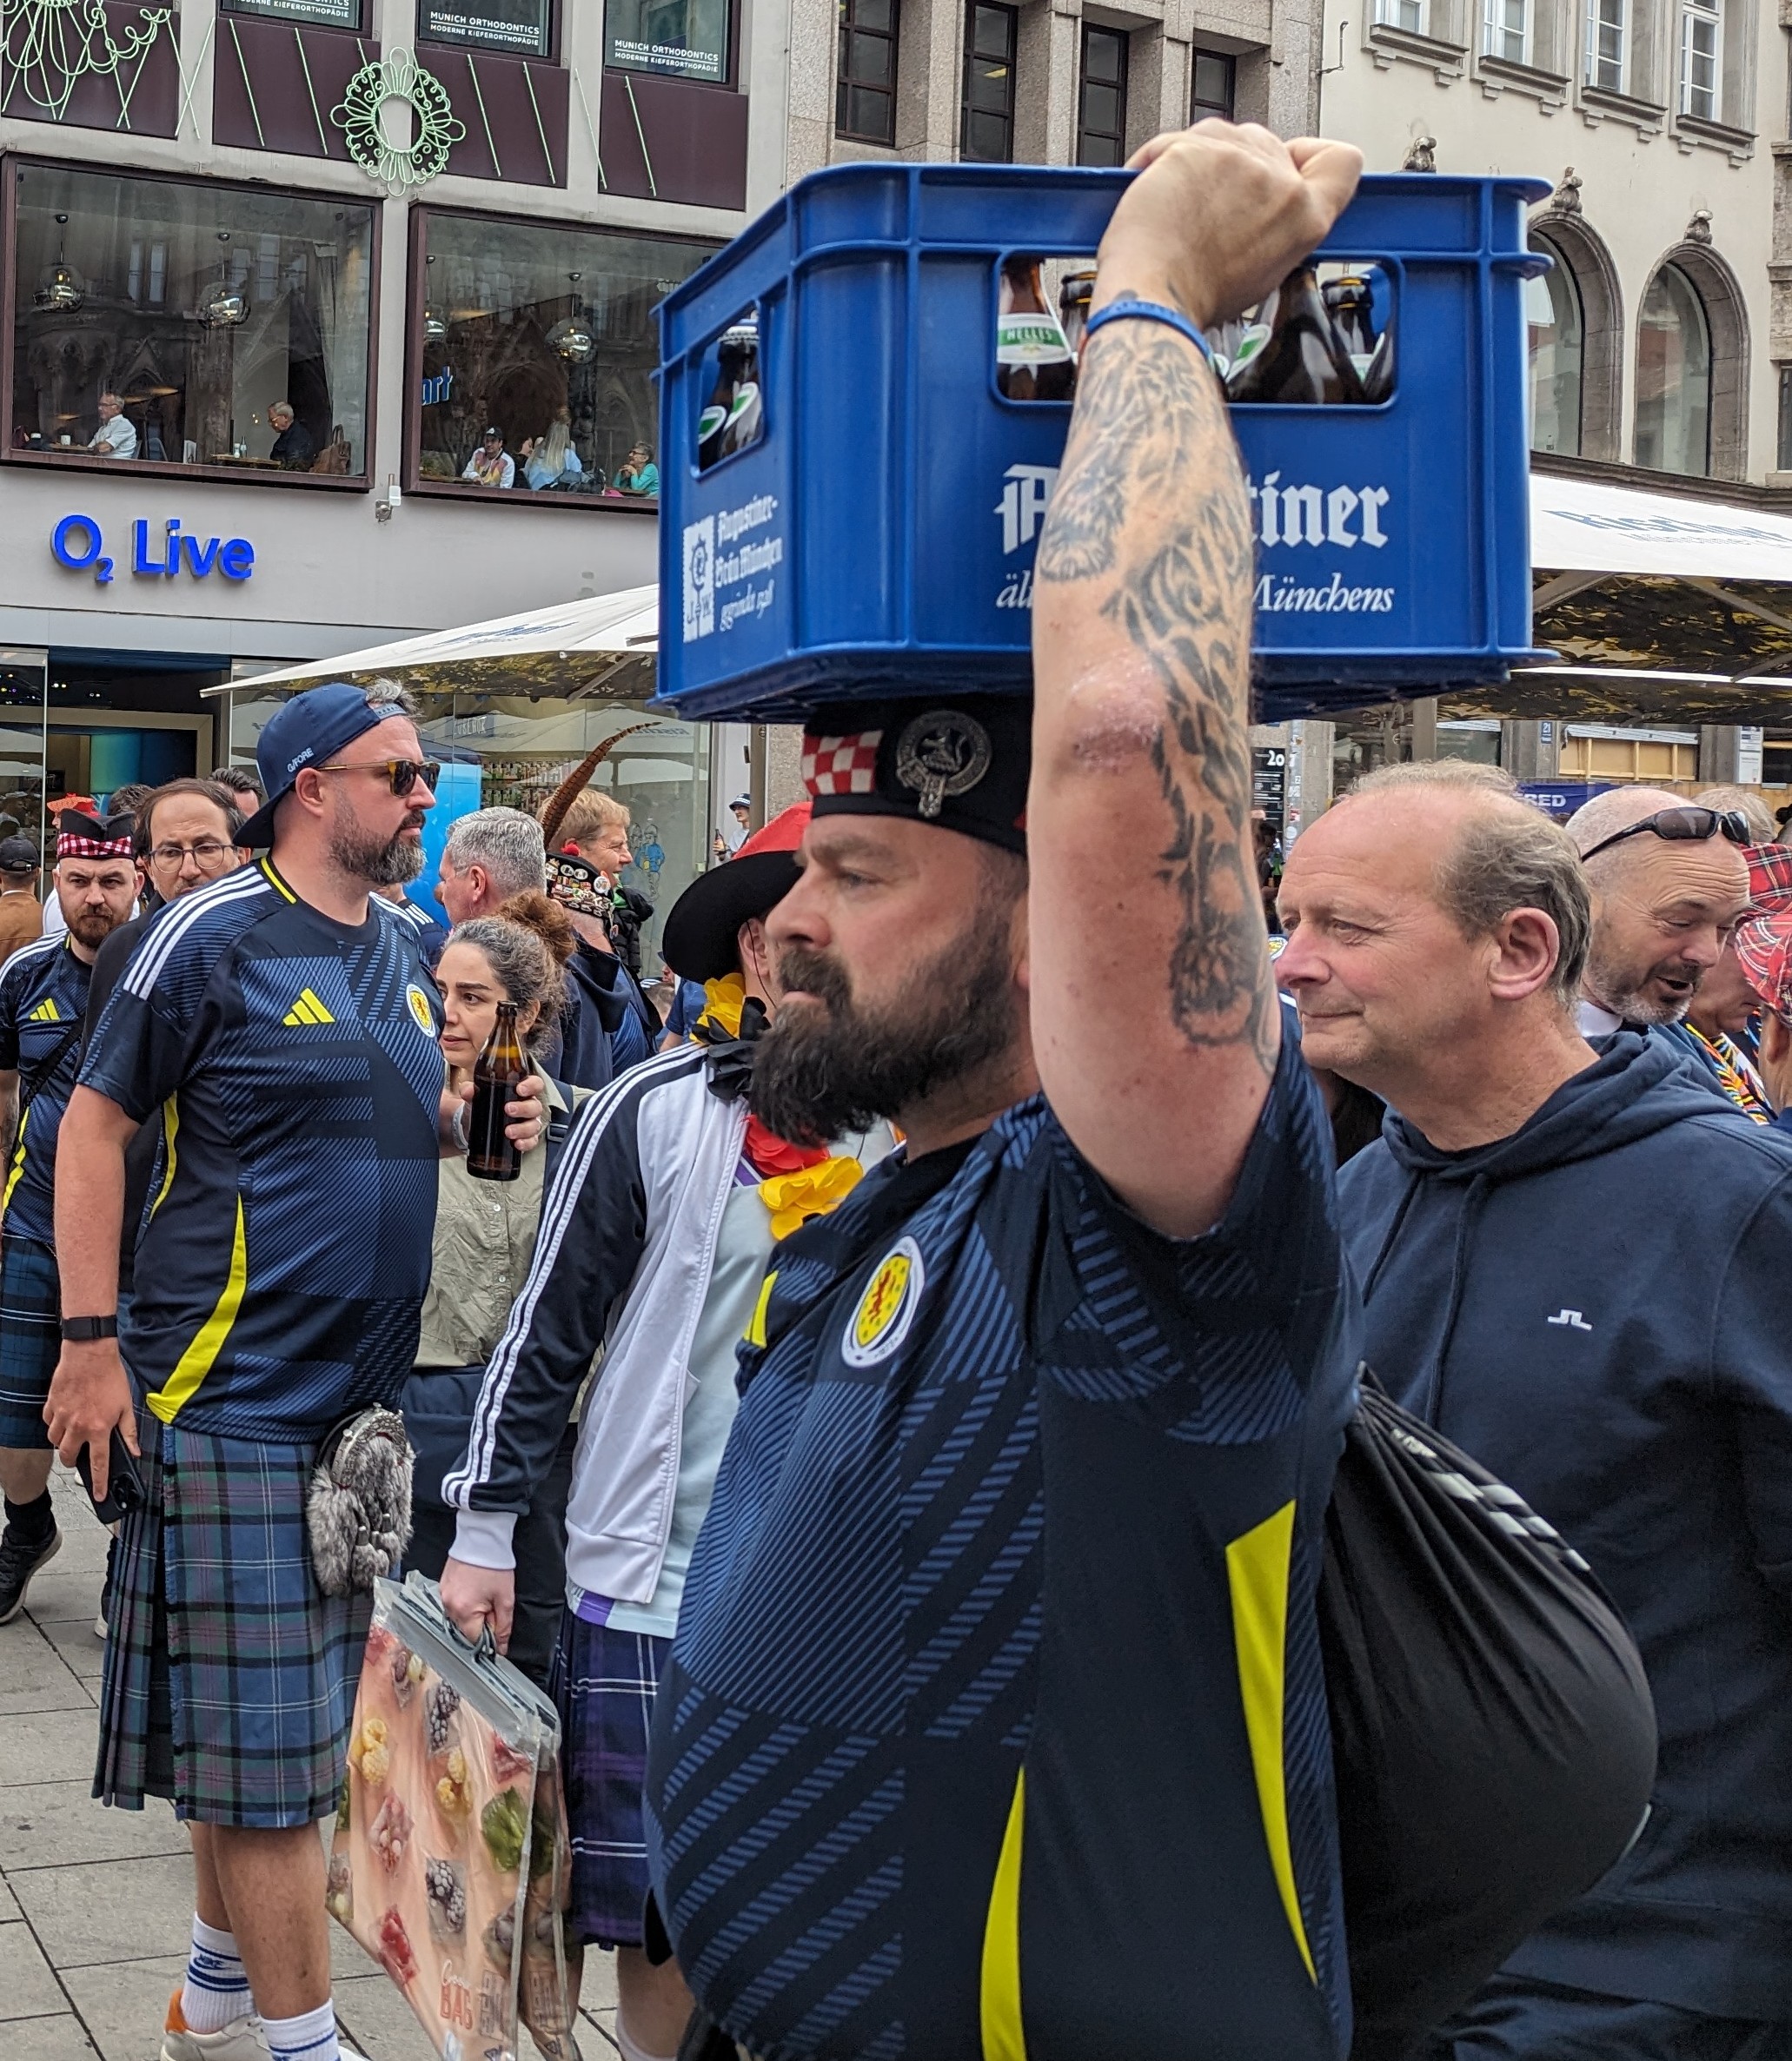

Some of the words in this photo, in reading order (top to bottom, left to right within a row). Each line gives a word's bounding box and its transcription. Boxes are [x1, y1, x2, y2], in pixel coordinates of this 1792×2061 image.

[273, 0, 349, 18] KIEFERORTHOPÄDIE
[430, 10, 467, 24] MUNICH
[468, 17, 540, 35] ORTHODONTICS
[430, 23, 466, 36] MODERNE
[614, 39, 649, 52] MUNICH
[651, 44, 719, 62] ORTHODONTICS
[614, 52, 648, 63] MODERNE
[132, 518, 256, 580] Live
[287, 747, 314, 772] G/FORE
[440, 1984, 474, 2030] BAG
